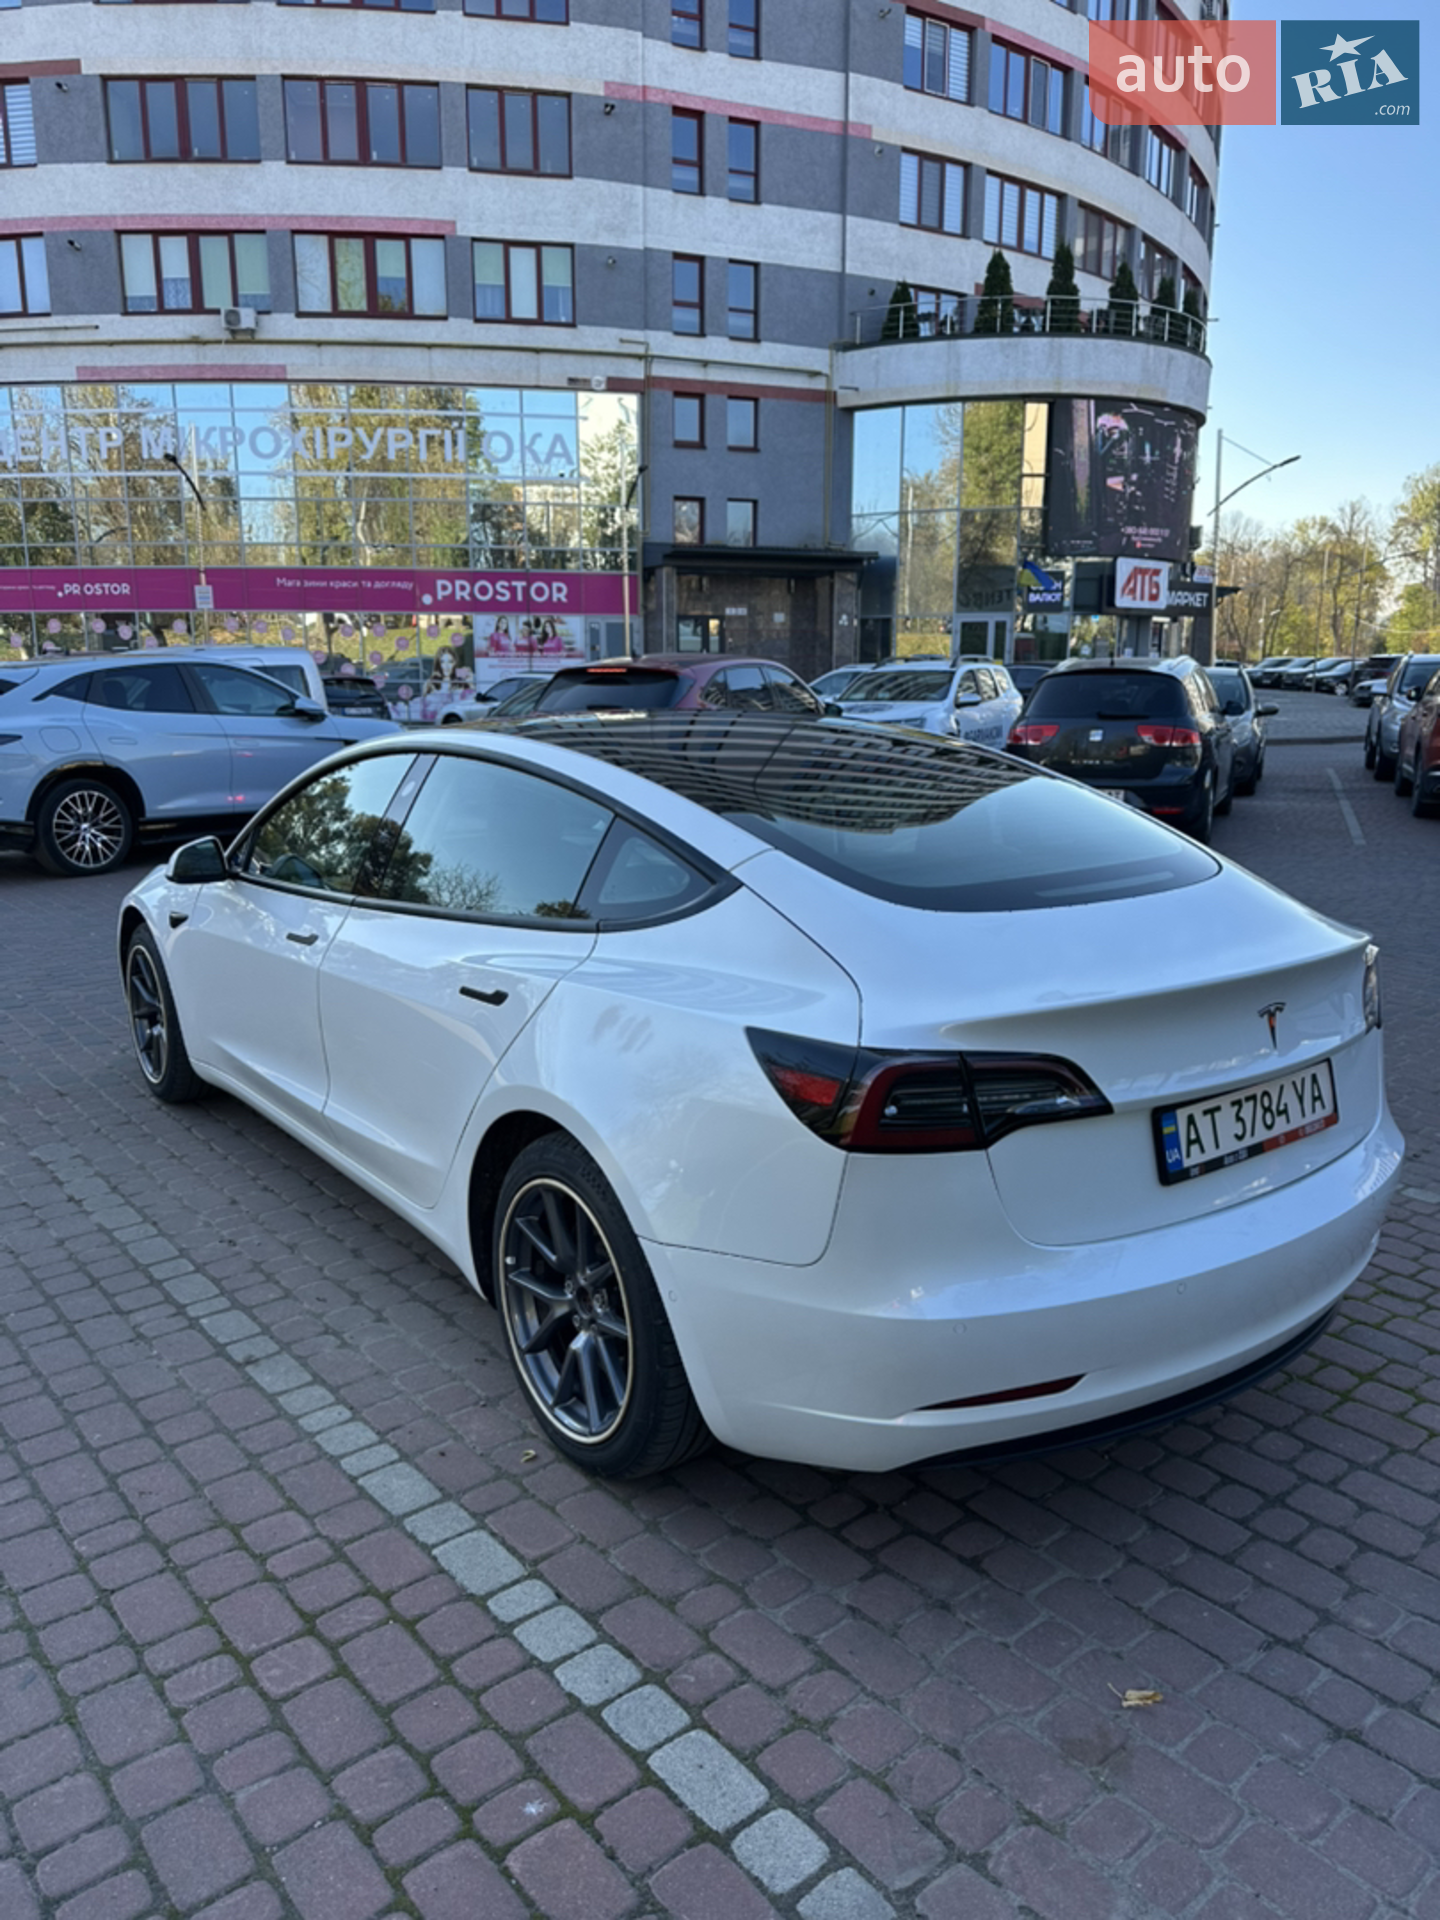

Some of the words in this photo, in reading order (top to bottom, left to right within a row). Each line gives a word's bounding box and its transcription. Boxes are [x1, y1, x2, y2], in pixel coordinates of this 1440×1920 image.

[482, 430, 574, 466] ОКА
[1120, 566, 1162, 602] АТБ
[1186, 1105, 1221, 1159] AT
[1231, 1083, 1291, 1142] 3784
[1292, 1072, 1327, 1119] YA
[1165, 1148, 1181, 1164] UA
